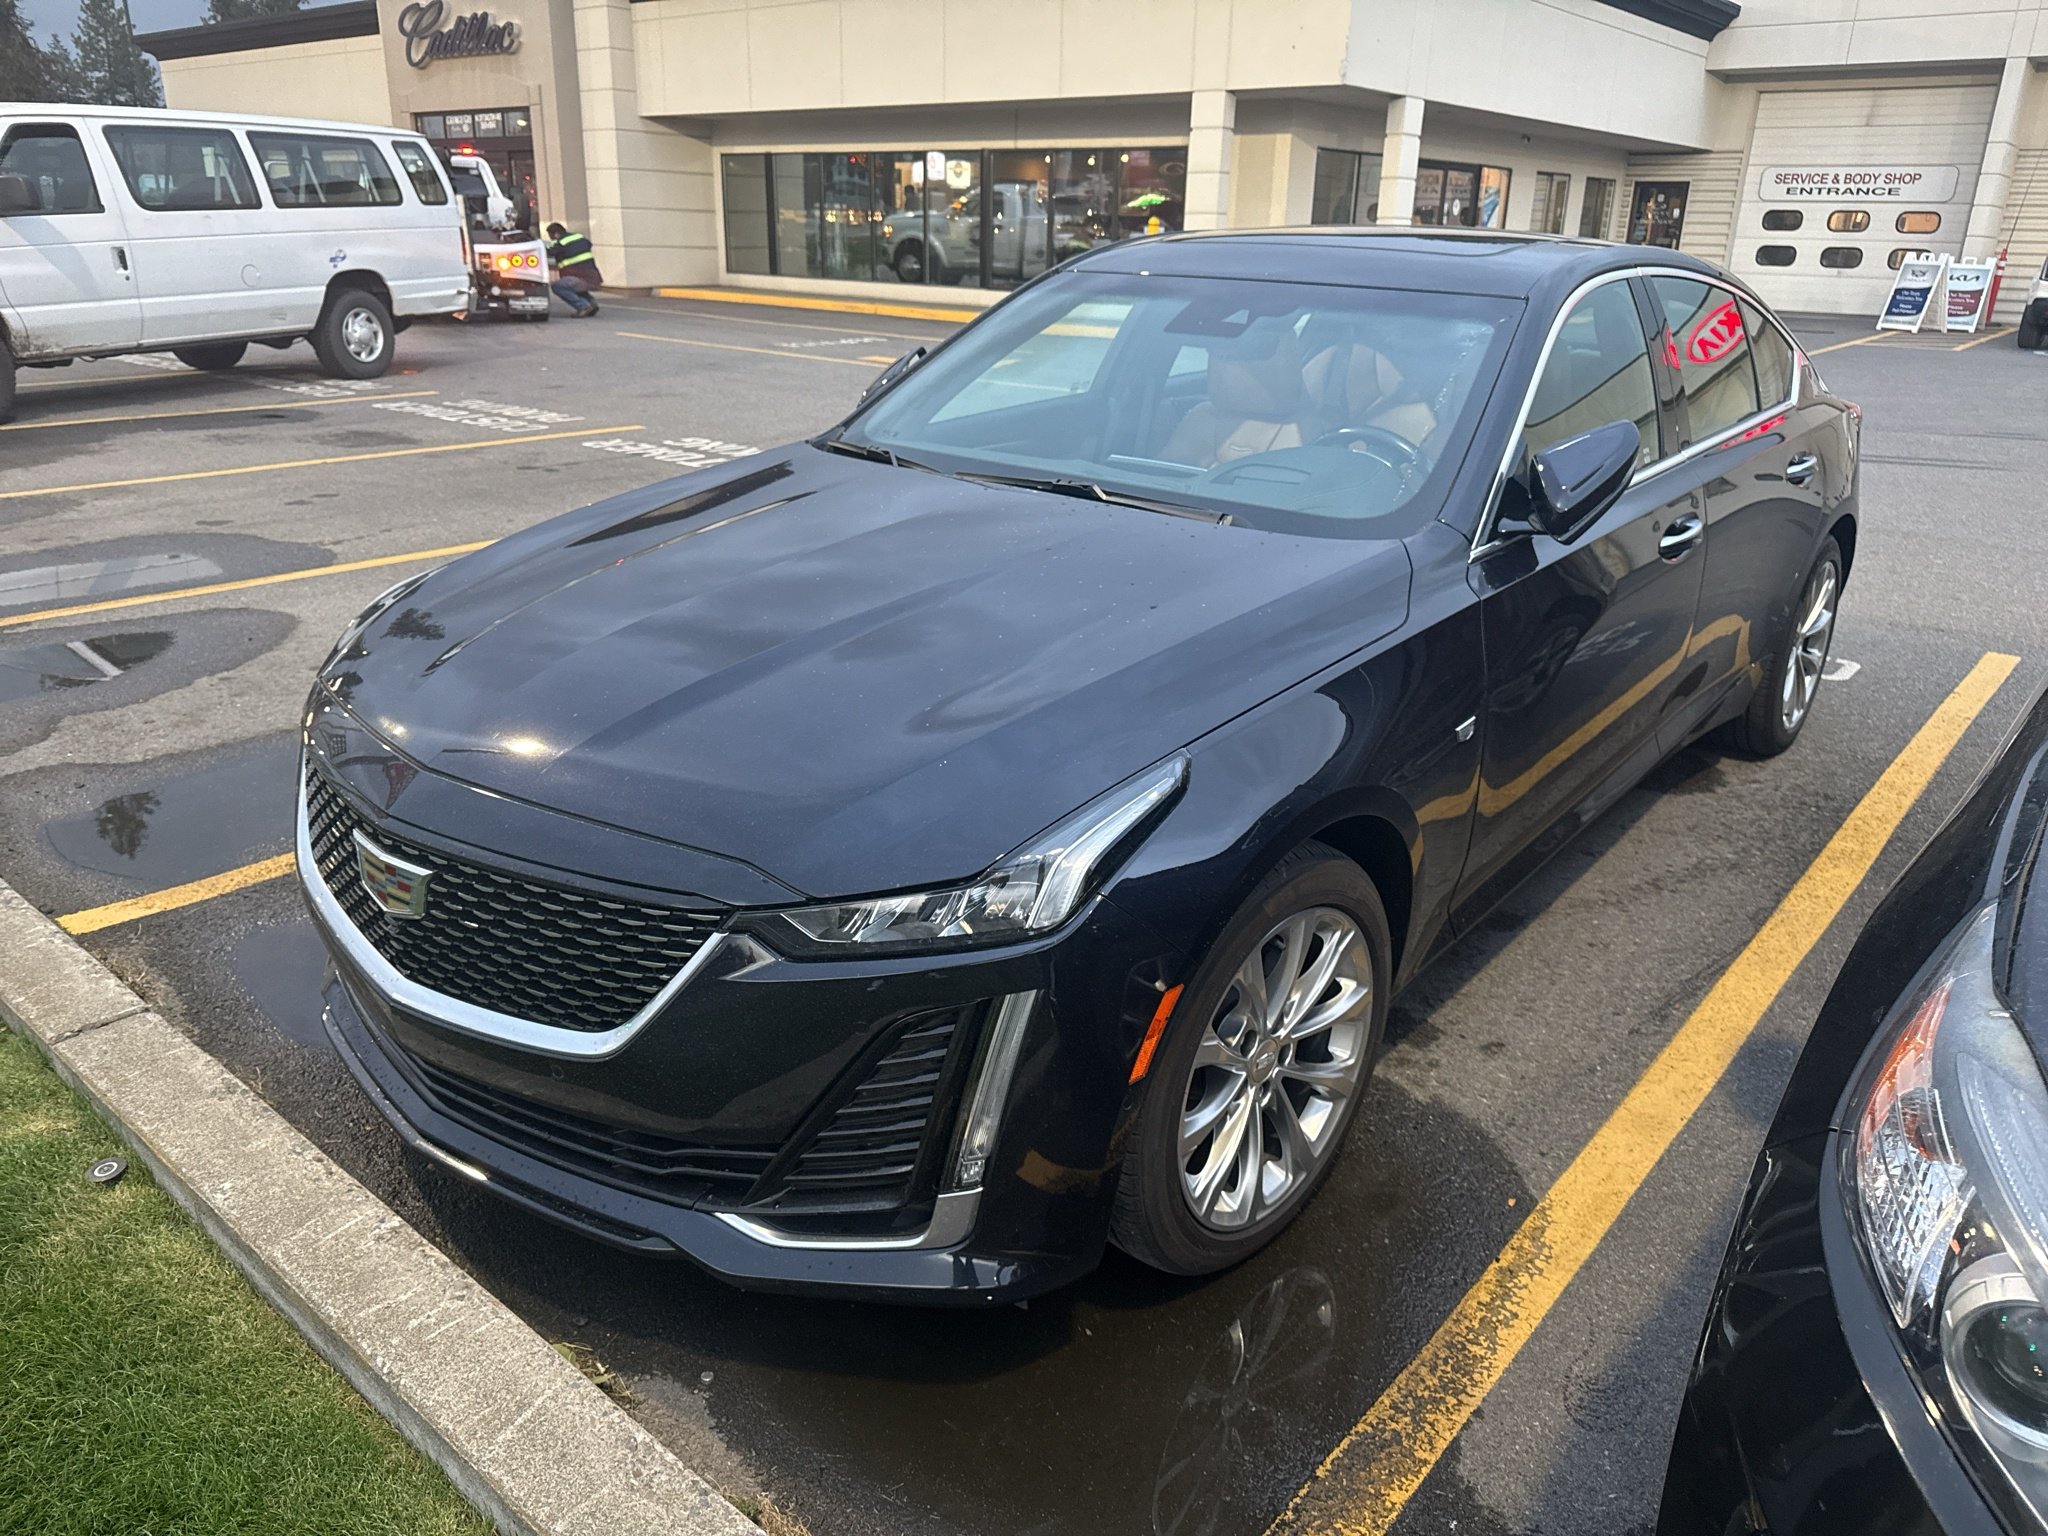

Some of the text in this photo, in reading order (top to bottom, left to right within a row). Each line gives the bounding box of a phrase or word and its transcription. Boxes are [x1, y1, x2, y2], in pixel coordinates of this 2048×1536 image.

[398, 0, 520, 69] Cadillac
[1774, 172, 1922, 185] SERVICE & BODY SHOP
[1786, 187, 1901, 196] ENTRANCE
